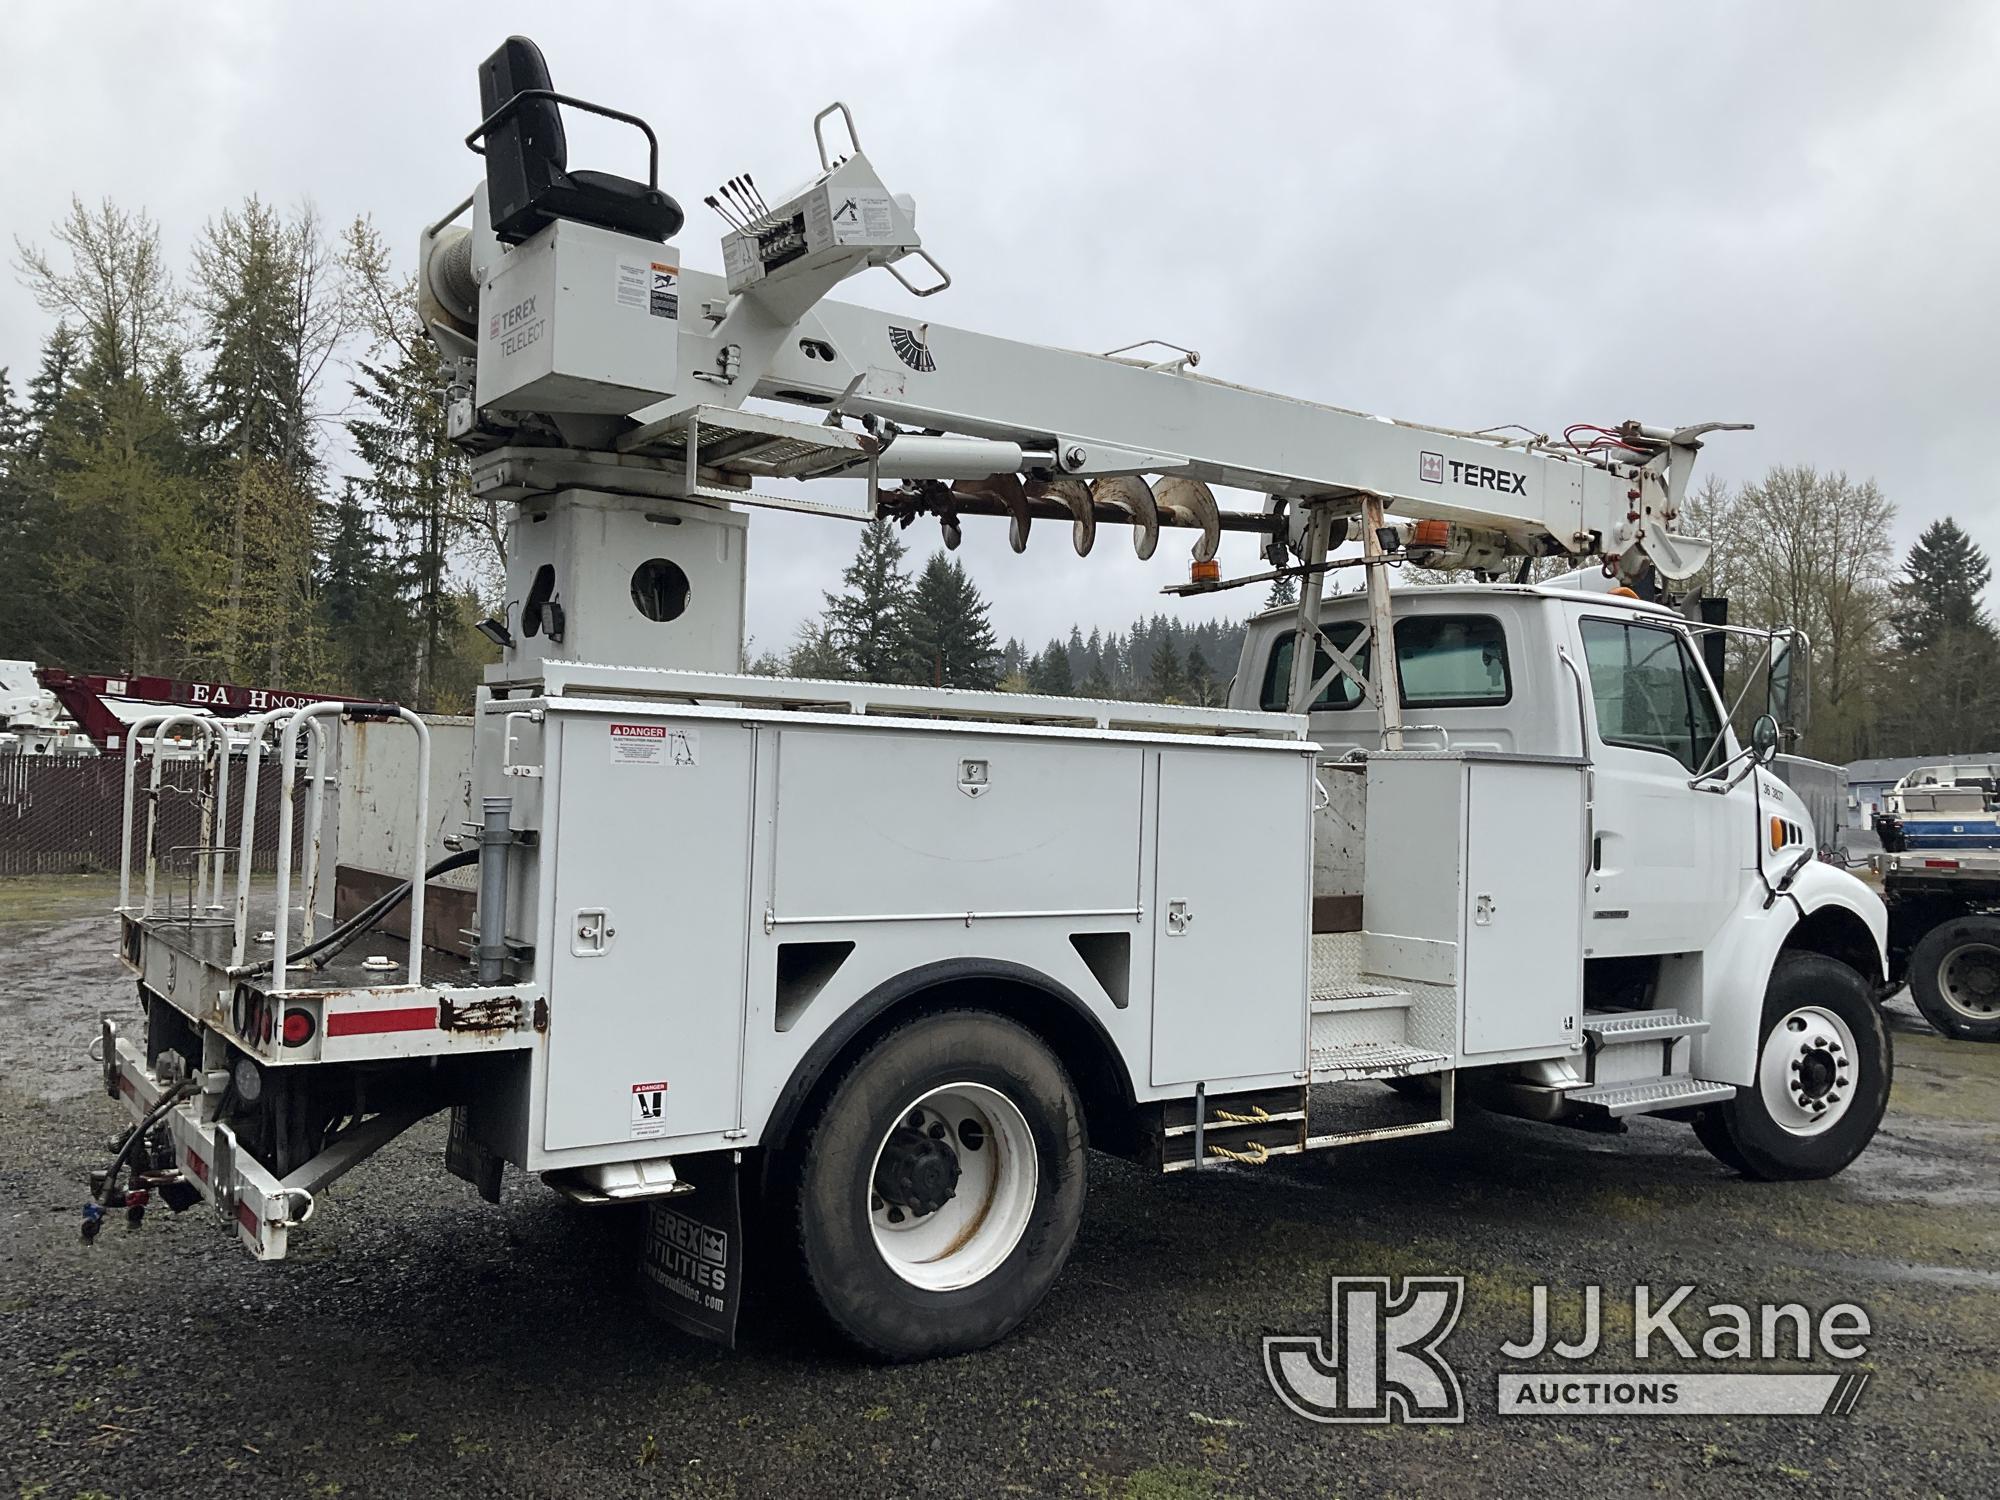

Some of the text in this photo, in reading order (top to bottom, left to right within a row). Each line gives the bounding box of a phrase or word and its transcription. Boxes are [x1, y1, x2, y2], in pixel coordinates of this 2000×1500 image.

[502, 295, 537, 330] TEREX
[500, 319, 545, 358] TELELECT
[1448, 460, 1527, 497] TEREX
[622, 726, 664, 737] DANGER
[641, 1083, 665, 1091] DANGER
[648, 1203, 701, 1254] TEREX
[646, 1233, 726, 1292] UTILITIES
